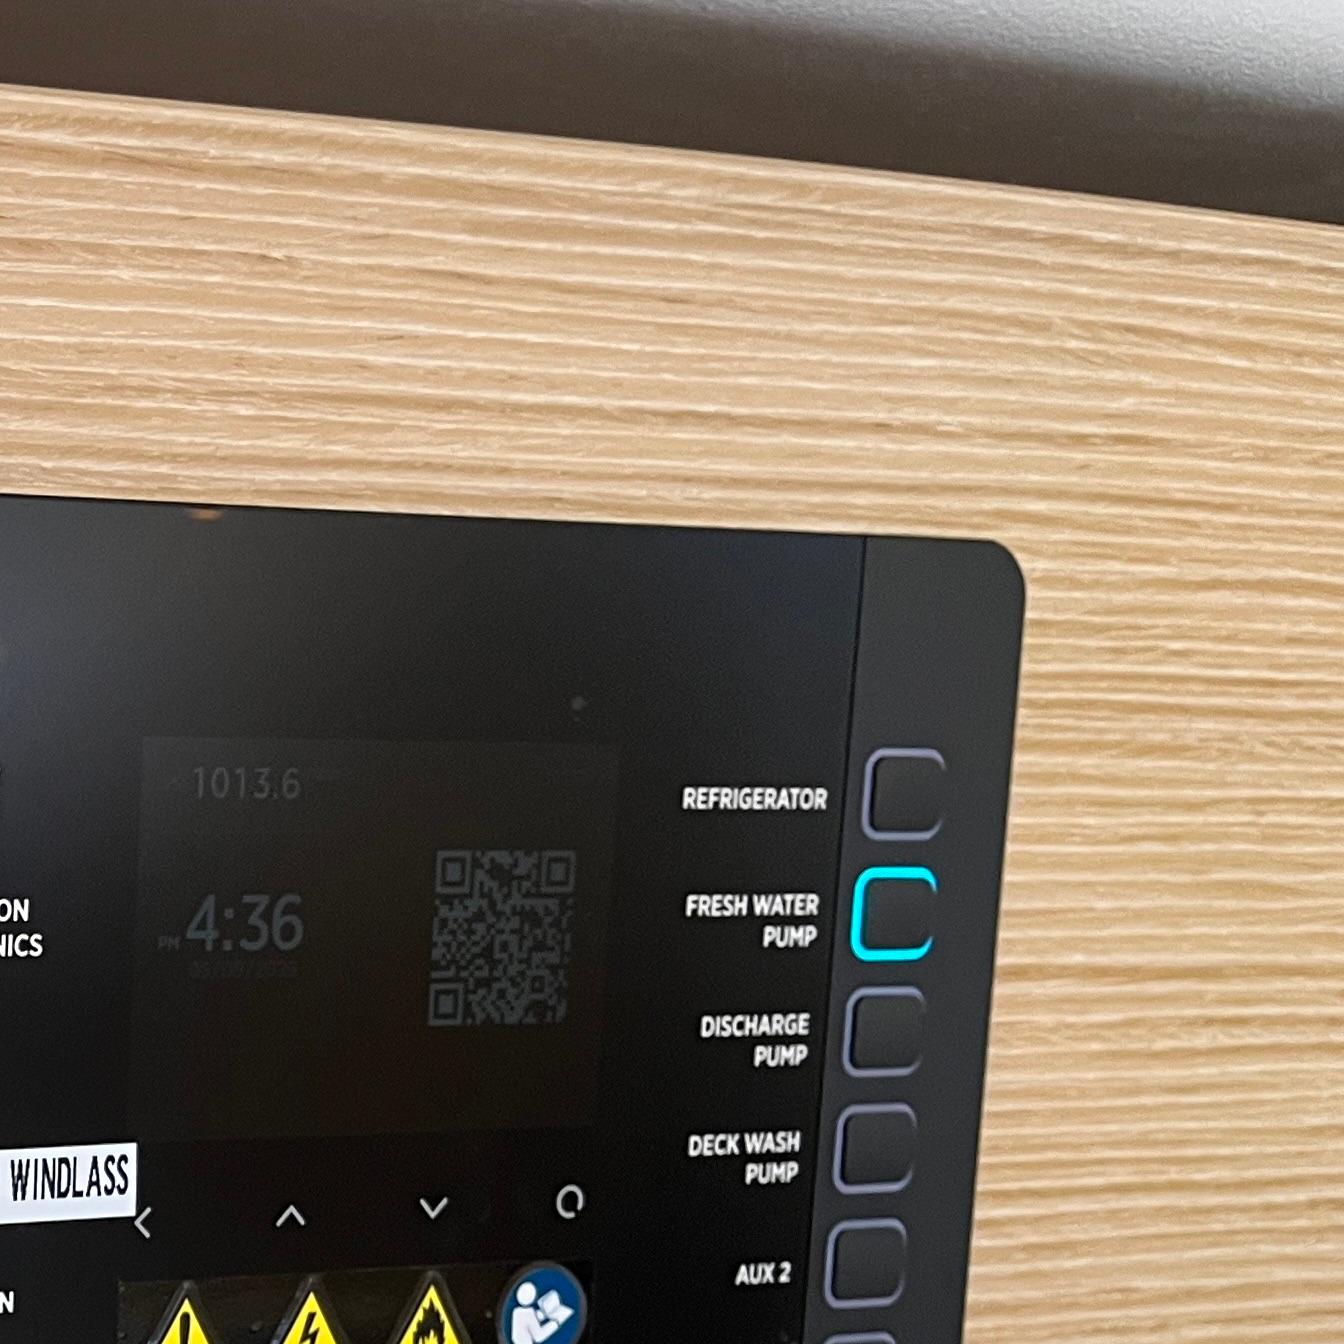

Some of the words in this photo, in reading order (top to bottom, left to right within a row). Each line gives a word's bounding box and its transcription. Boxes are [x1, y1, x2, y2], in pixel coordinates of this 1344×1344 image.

[188, 763, 302, 800] 1013.6
[682, 787, 828, 810] REFRIGERATOR
[686, 894, 748, 917] FRESH
[753, 893, 819, 916] WATER
[185, 893, 306, 953] 4:36
[763, 925, 817, 948] PUMP
[701, 1013, 810, 1038] DISCHARGE
[754, 1044, 809, 1067] PUMP
[688, 1133, 740, 1157] DECK
[744, 1131, 801, 1154] WASH
[10, 1154, 128, 1202] WINDLASS
[745, 1161, 799, 1185] PUMP
[735, 1262, 775, 1286] AUX
[778, 1261, 792, 1284] 2
